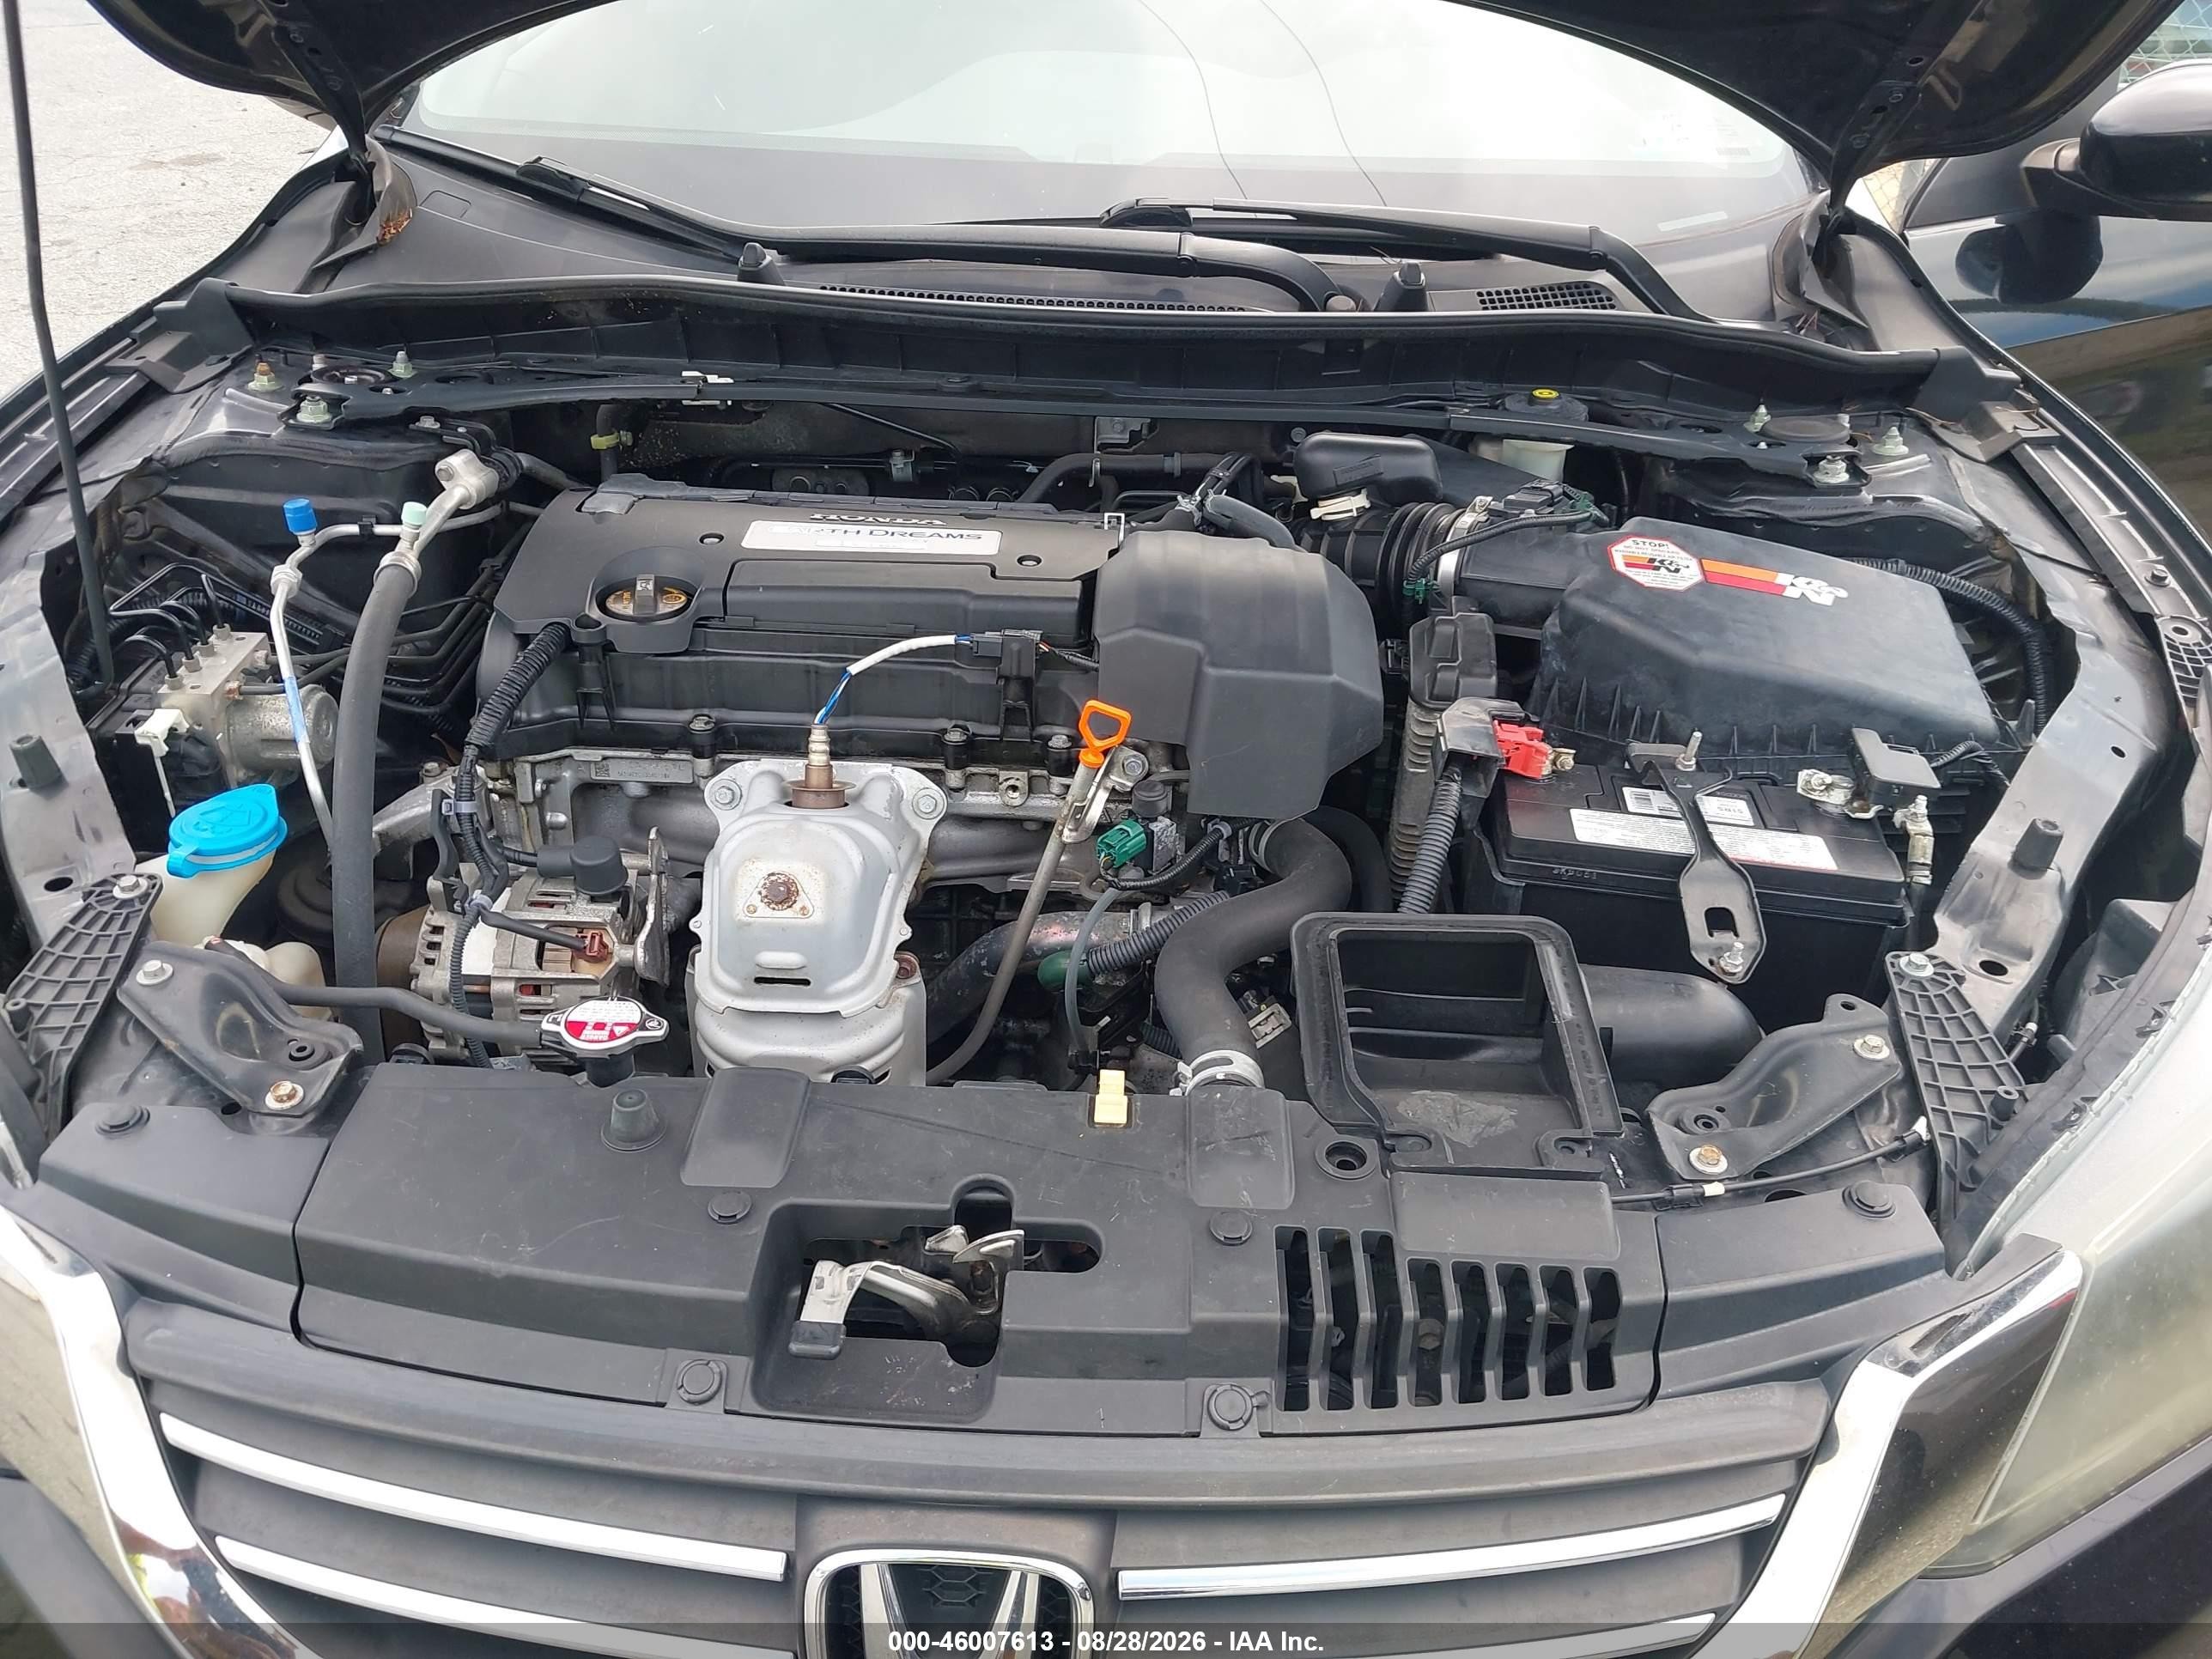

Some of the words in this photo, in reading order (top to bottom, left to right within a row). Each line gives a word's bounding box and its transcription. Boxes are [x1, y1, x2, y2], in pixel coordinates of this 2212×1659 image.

[810, 514, 947, 526] HONDA
[868, 528, 982, 541] DREAMS
[1632, 539, 1669, 550] STOP!
